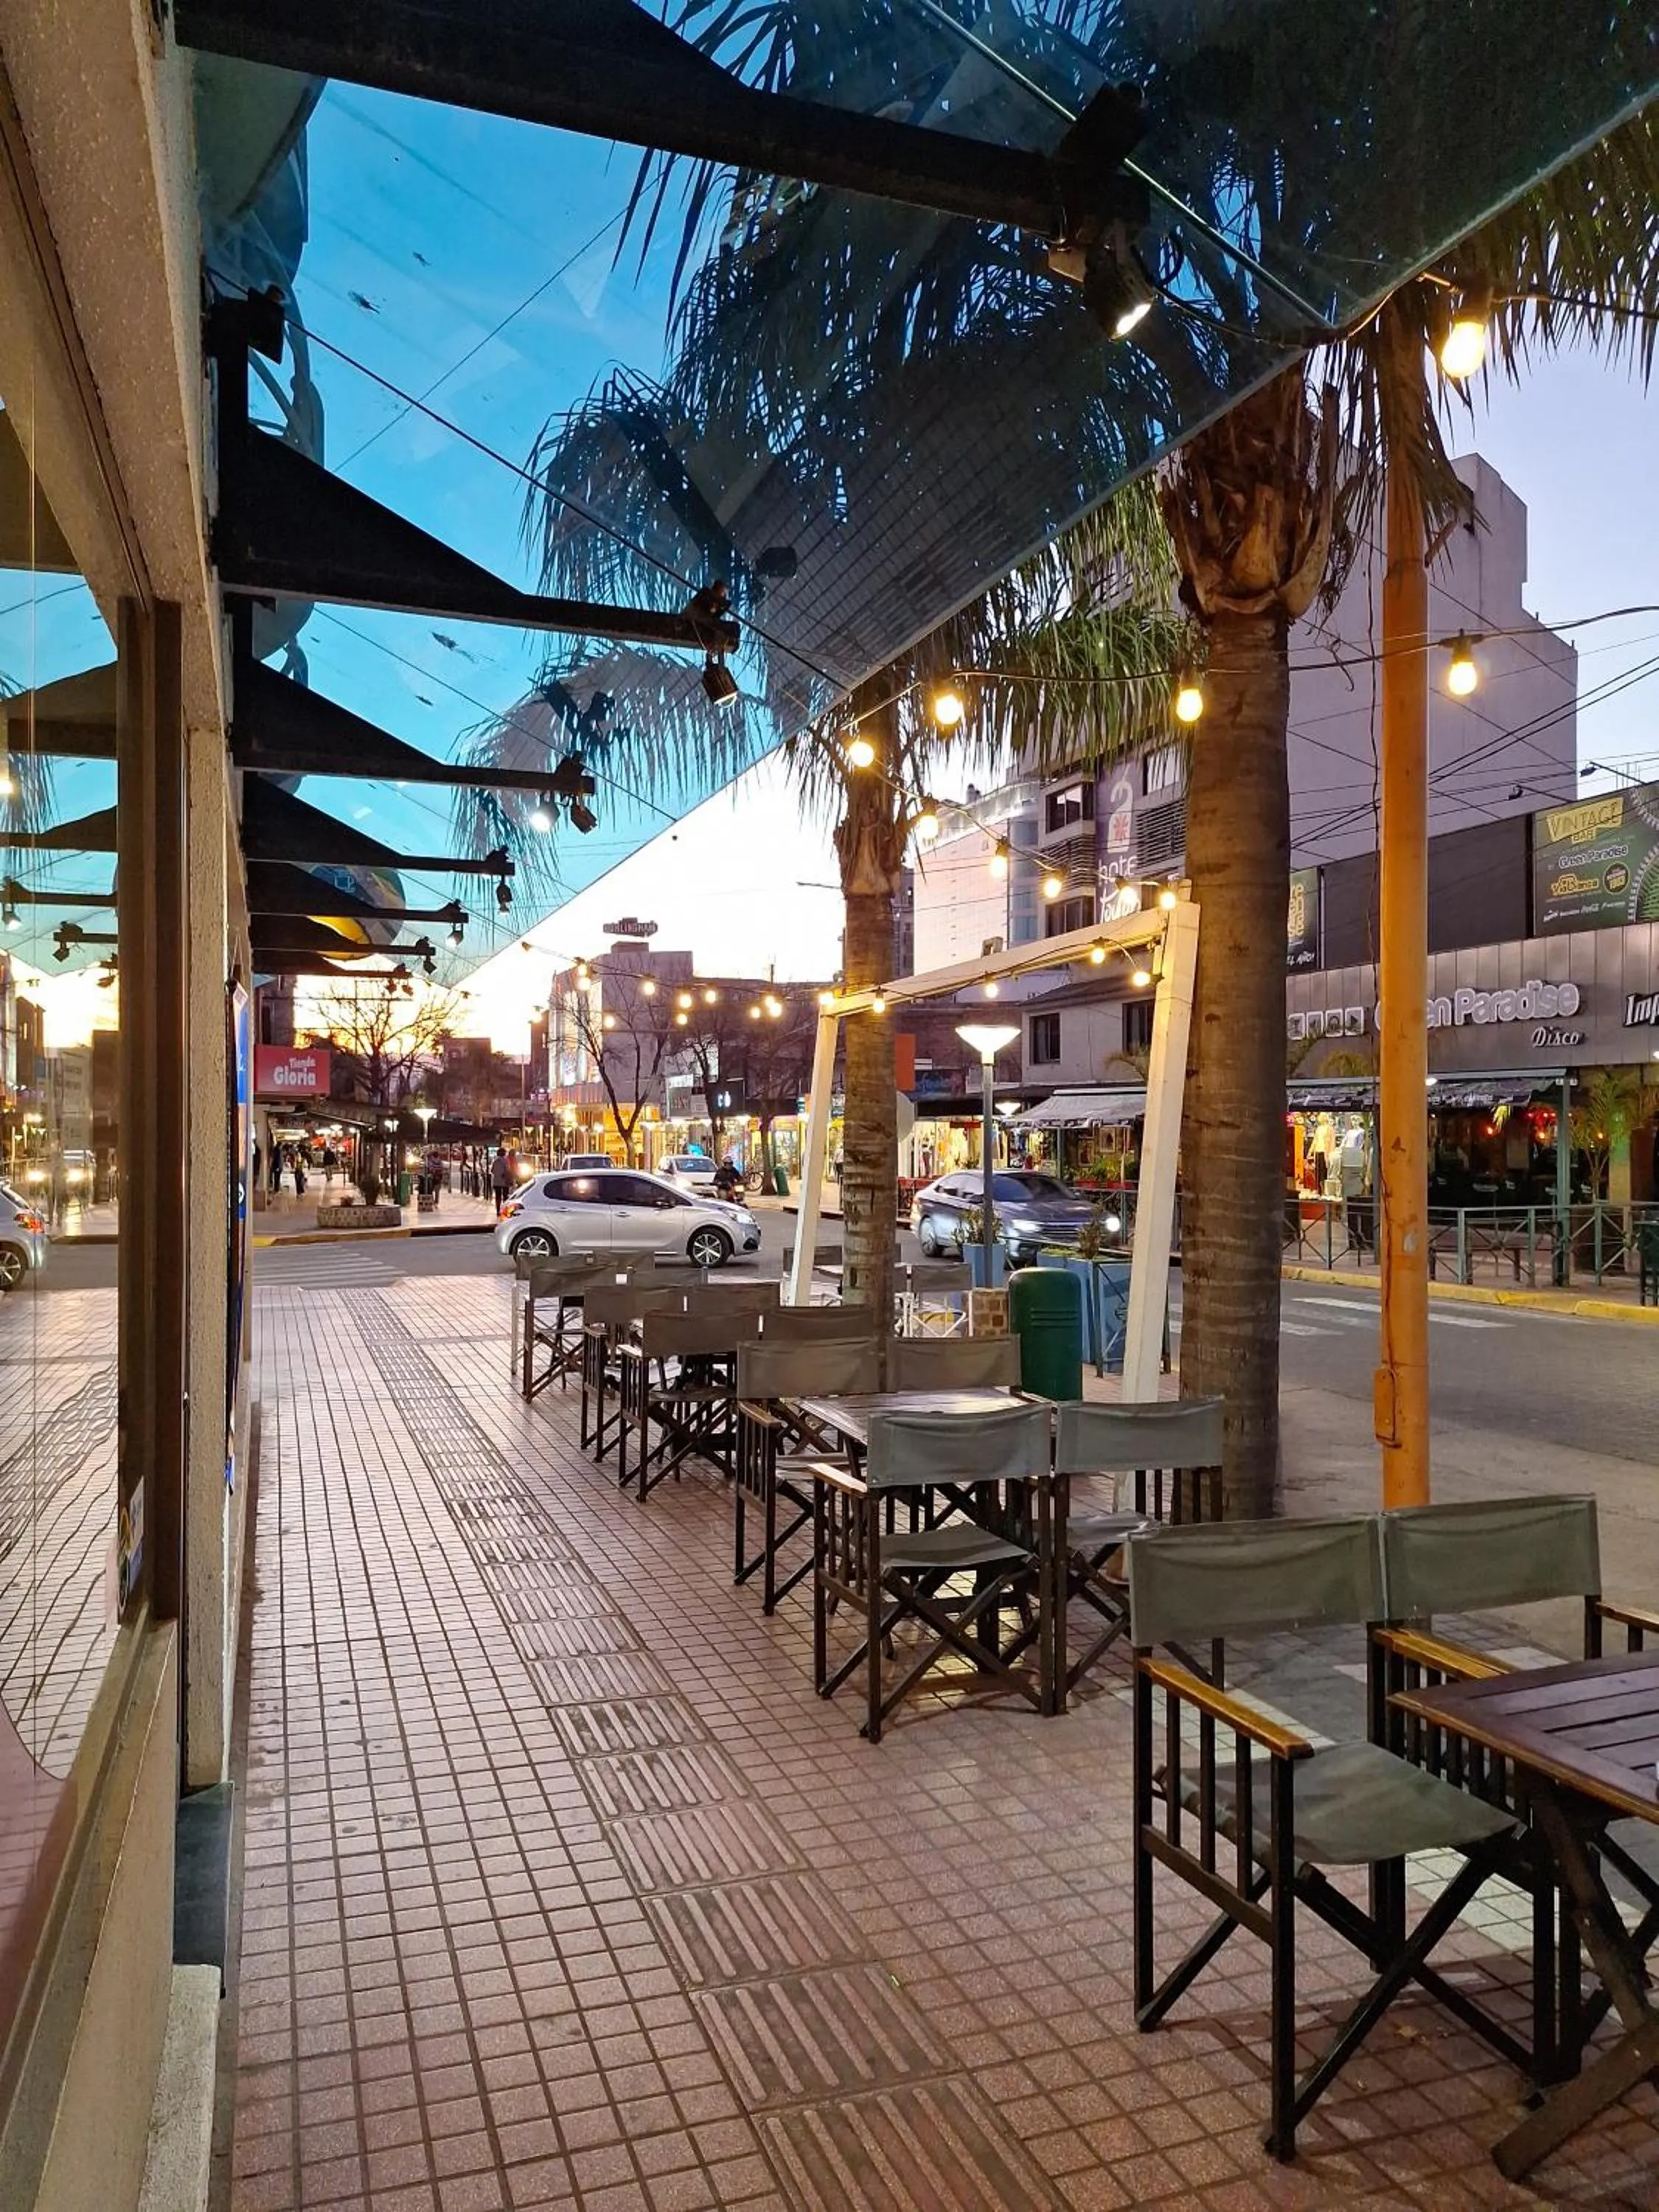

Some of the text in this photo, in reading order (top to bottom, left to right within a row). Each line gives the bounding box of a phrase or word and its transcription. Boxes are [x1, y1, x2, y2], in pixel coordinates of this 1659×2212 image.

[1454, 980, 1580, 1026] Paradise
[1531, 1026, 1581, 1048] Disco
[274, 1065, 316, 1086] Gloria
